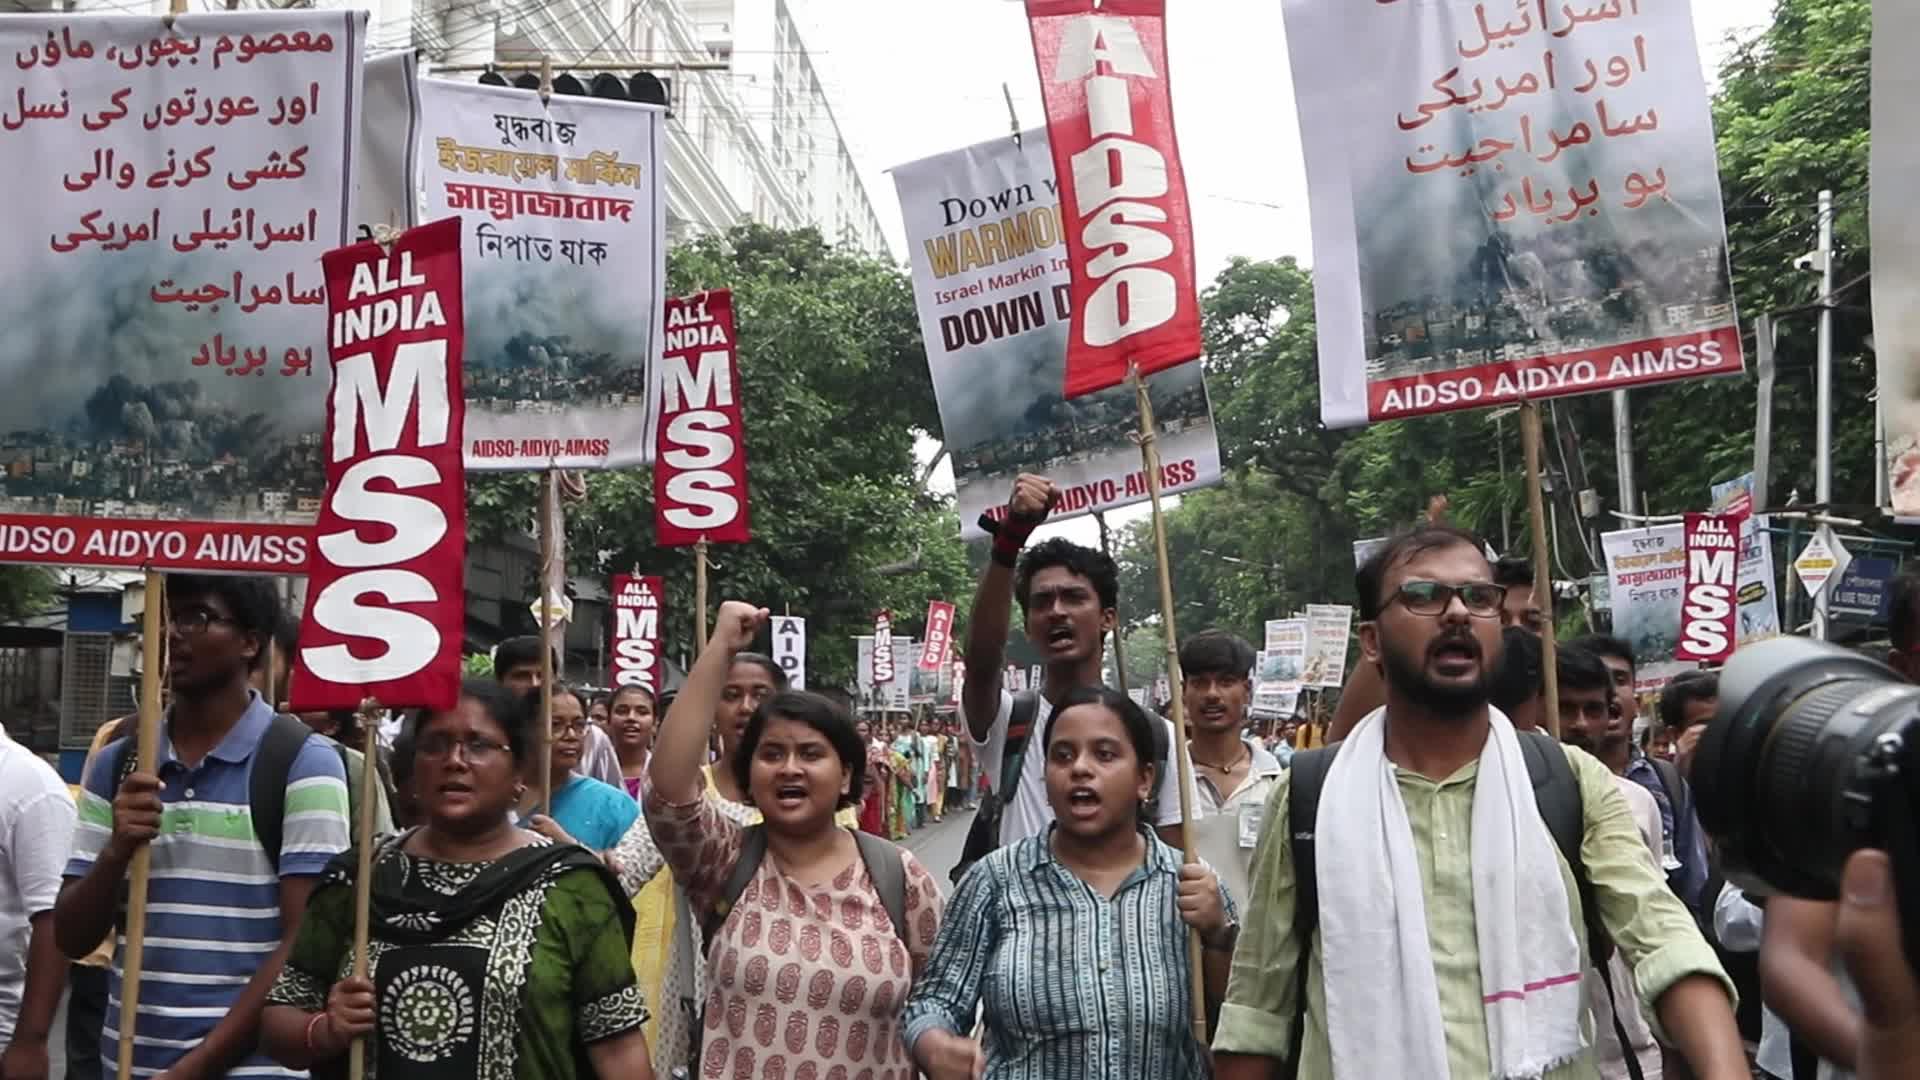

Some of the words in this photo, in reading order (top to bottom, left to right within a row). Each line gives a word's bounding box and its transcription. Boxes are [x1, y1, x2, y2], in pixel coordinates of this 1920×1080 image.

[15, 26, 94, 69] ماؤں
[212, 29, 334, 69] معصوم
[1574, 34, 1647, 93] اور
[2, 88, 71, 131] نسل
[82, 87, 132, 131] کی
[142, 88, 259, 130] عورتوں
[267, 82, 320, 126] اور
[1396, 51, 1556, 131] امریکی
[493, 113, 577, 147] যুদ্ধবাজ
[62, 149, 135, 192] والی
[145, 146, 216, 189] کرنے
[227, 146, 309, 190] کشی
[1055, 14, 1177, 347] AIDSO
[444, 182, 634, 223] সাম্রাজ্যবাদ
[939, 183, 1035, 227] Down
[50, 208, 160, 253] امریکی
[172, 208, 317, 252] اسرائیلی
[476, 222, 553, 262] নিপাত
[559, 238, 609, 267] যাক
[347, 251, 426, 302] ALL
[934, 280, 985, 306] Israel
[988, 263, 1046, 292] Markin
[333, 290, 448, 349] INDIA
[667, 303, 715, 328] ALL
[667, 324, 728, 351] NDIA
[940, 291, 1046, 353] DOWN
[191, 333, 268, 377] برباد
[1380, 375, 1483, 414] AIDSO
[1491, 359, 1598, 398] AIDYO
[1606, 340, 1724, 381] AIMSS
[662, 350, 740, 530] MSS
[301, 339, 450, 684] MSS
[1695, 520, 1729, 534] ALL
[0, 523, 76, 556] IDSO
[82, 529, 188, 560] AIDYO
[194, 533, 308, 565] AIMSS
[1688, 534, 1736, 549] INDIA
[616, 594, 658, 608] INDIA
[623, 583, 652, 595] ALL
[1681, 549, 1736, 656] MSS
[925, 608, 948, 664] AIDSO
